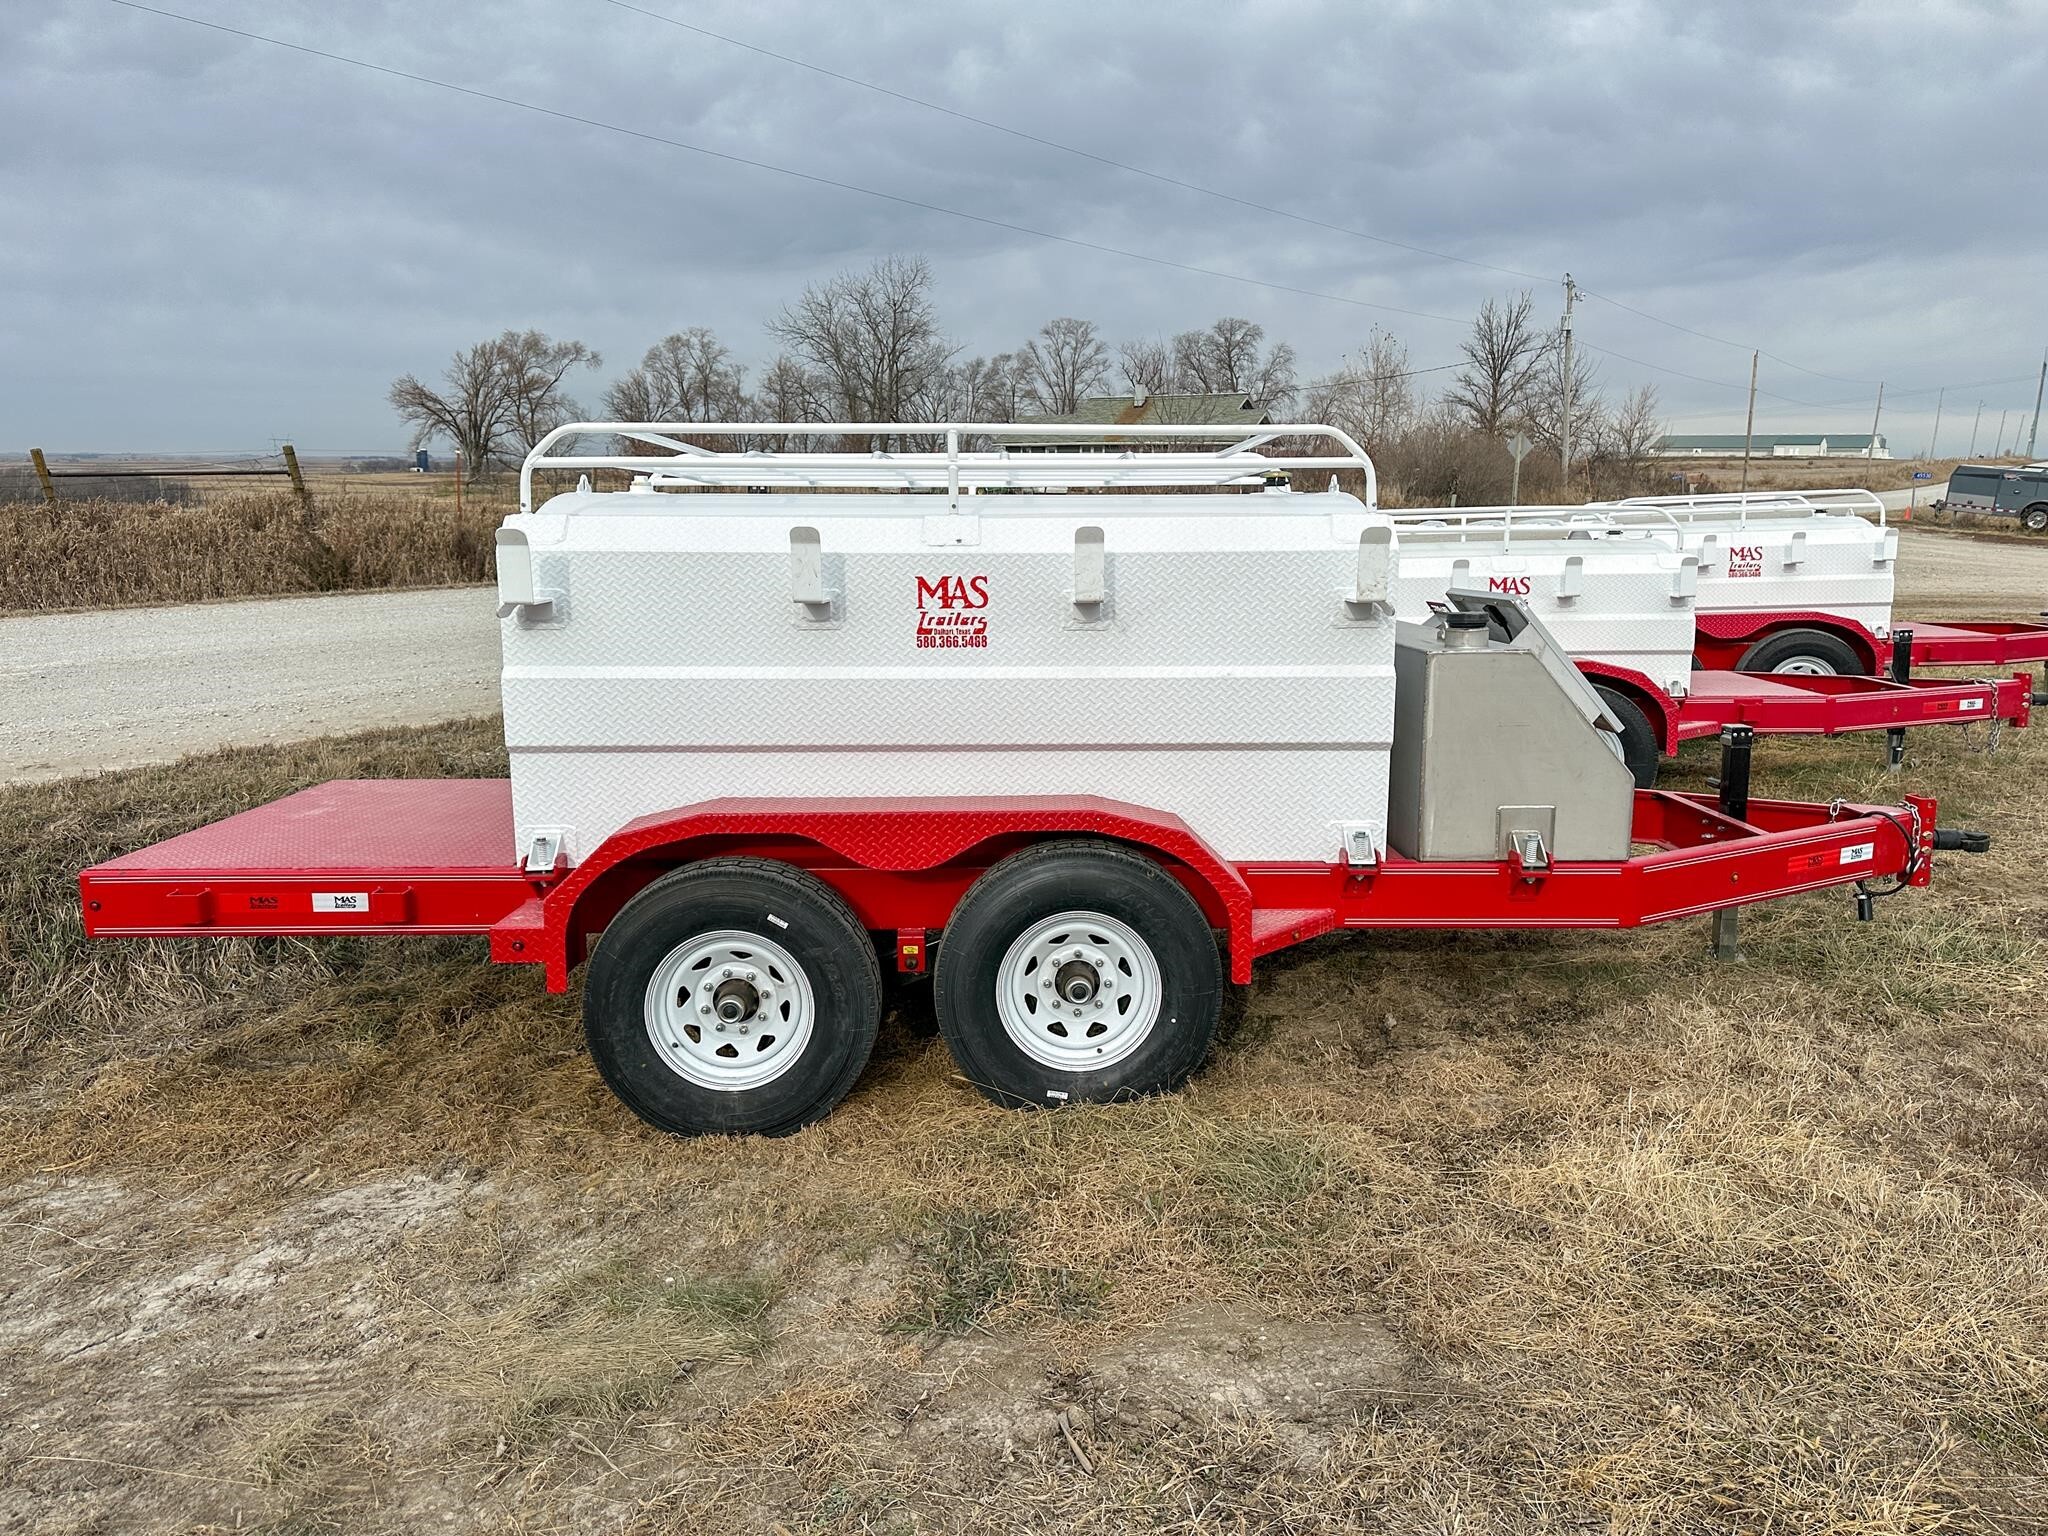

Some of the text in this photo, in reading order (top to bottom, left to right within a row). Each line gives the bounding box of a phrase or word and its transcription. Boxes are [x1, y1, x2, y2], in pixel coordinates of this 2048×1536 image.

[1729, 546, 1763, 561] MAS
[914, 575, 989, 609] MAS
[1488, 576, 1531, 595] MAS
[916, 611, 988, 636] Trailers
